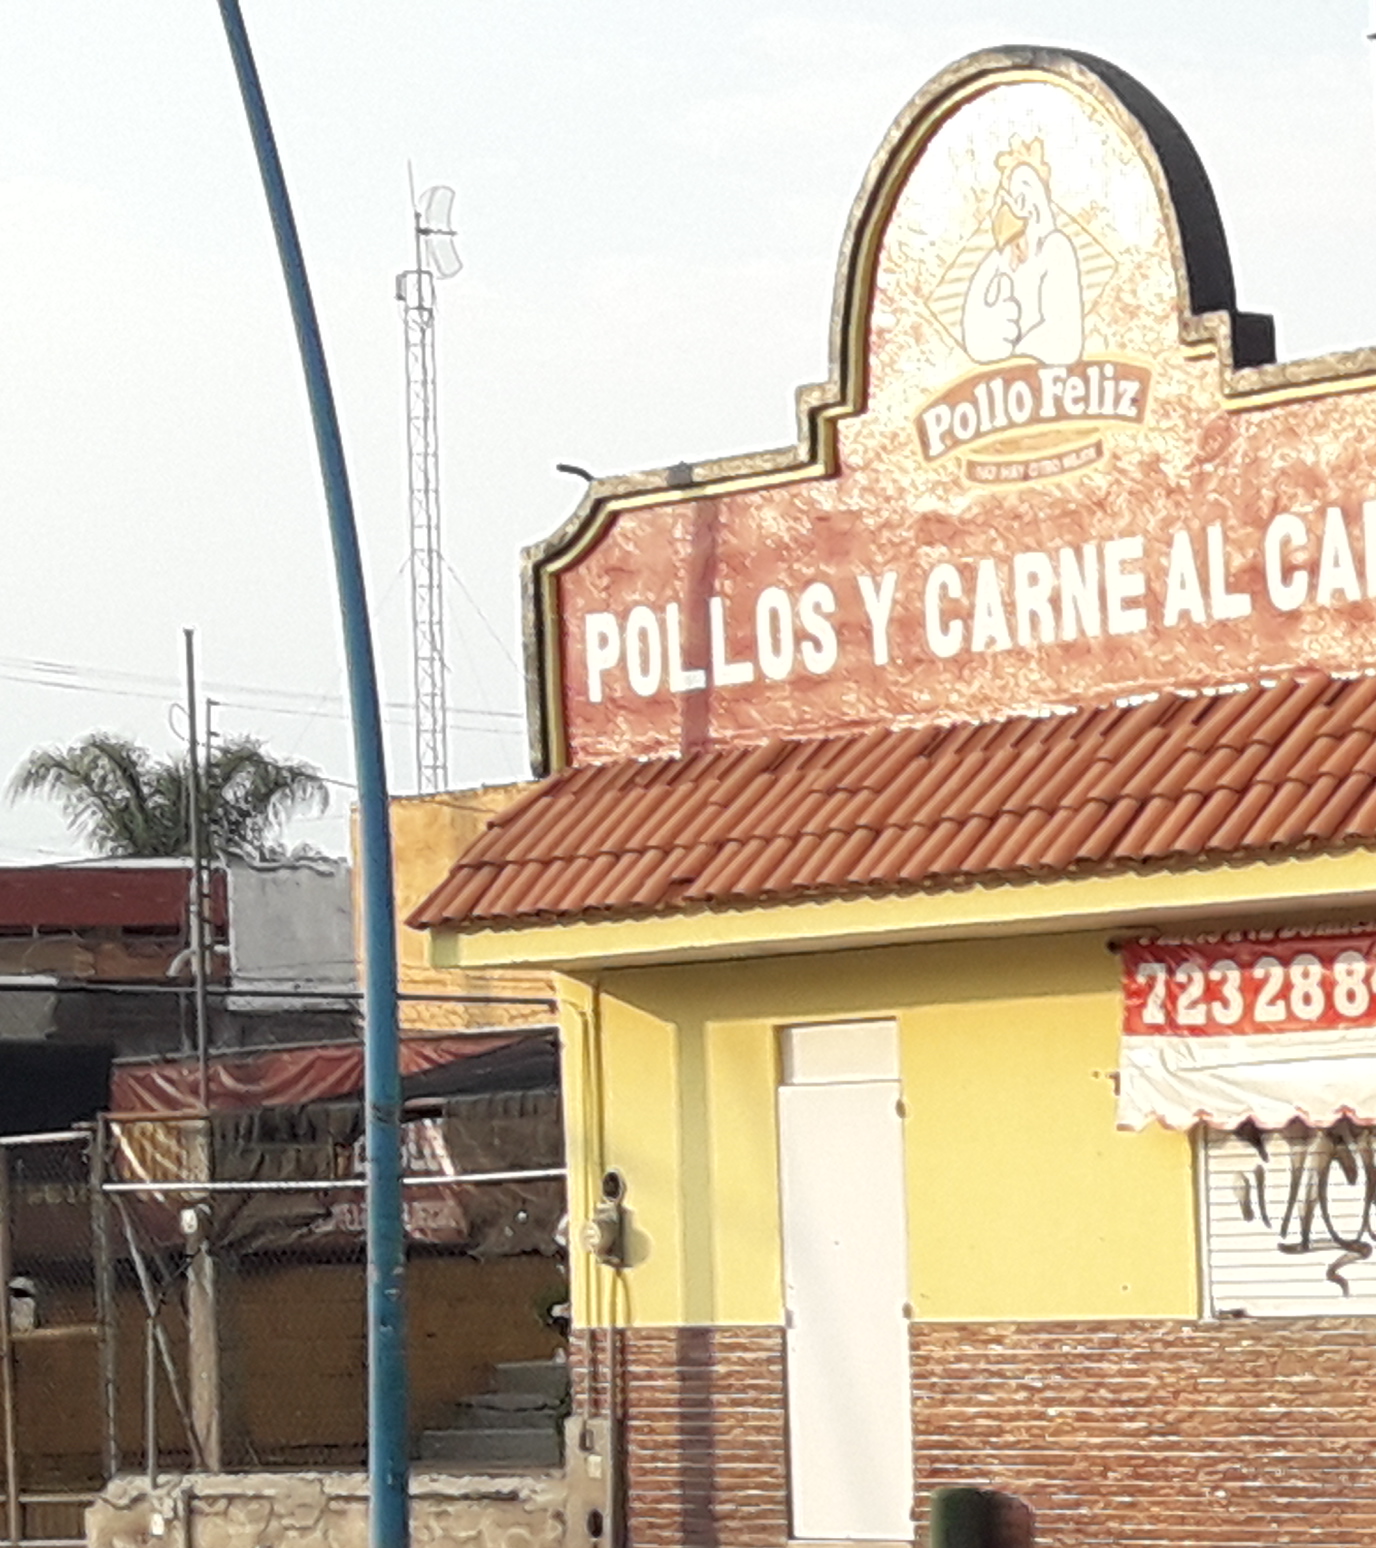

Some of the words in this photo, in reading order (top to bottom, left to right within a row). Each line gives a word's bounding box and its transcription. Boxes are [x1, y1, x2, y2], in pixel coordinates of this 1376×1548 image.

[922, 376, 1034, 457] Pollo
[1037, 363, 1141, 418] Feliz
[584, 582, 839, 703] POLLOS
[856, 570, 898, 667] Y
[923, 534, 1148, 659] CARNE
[1163, 520, 1252, 628] AL
